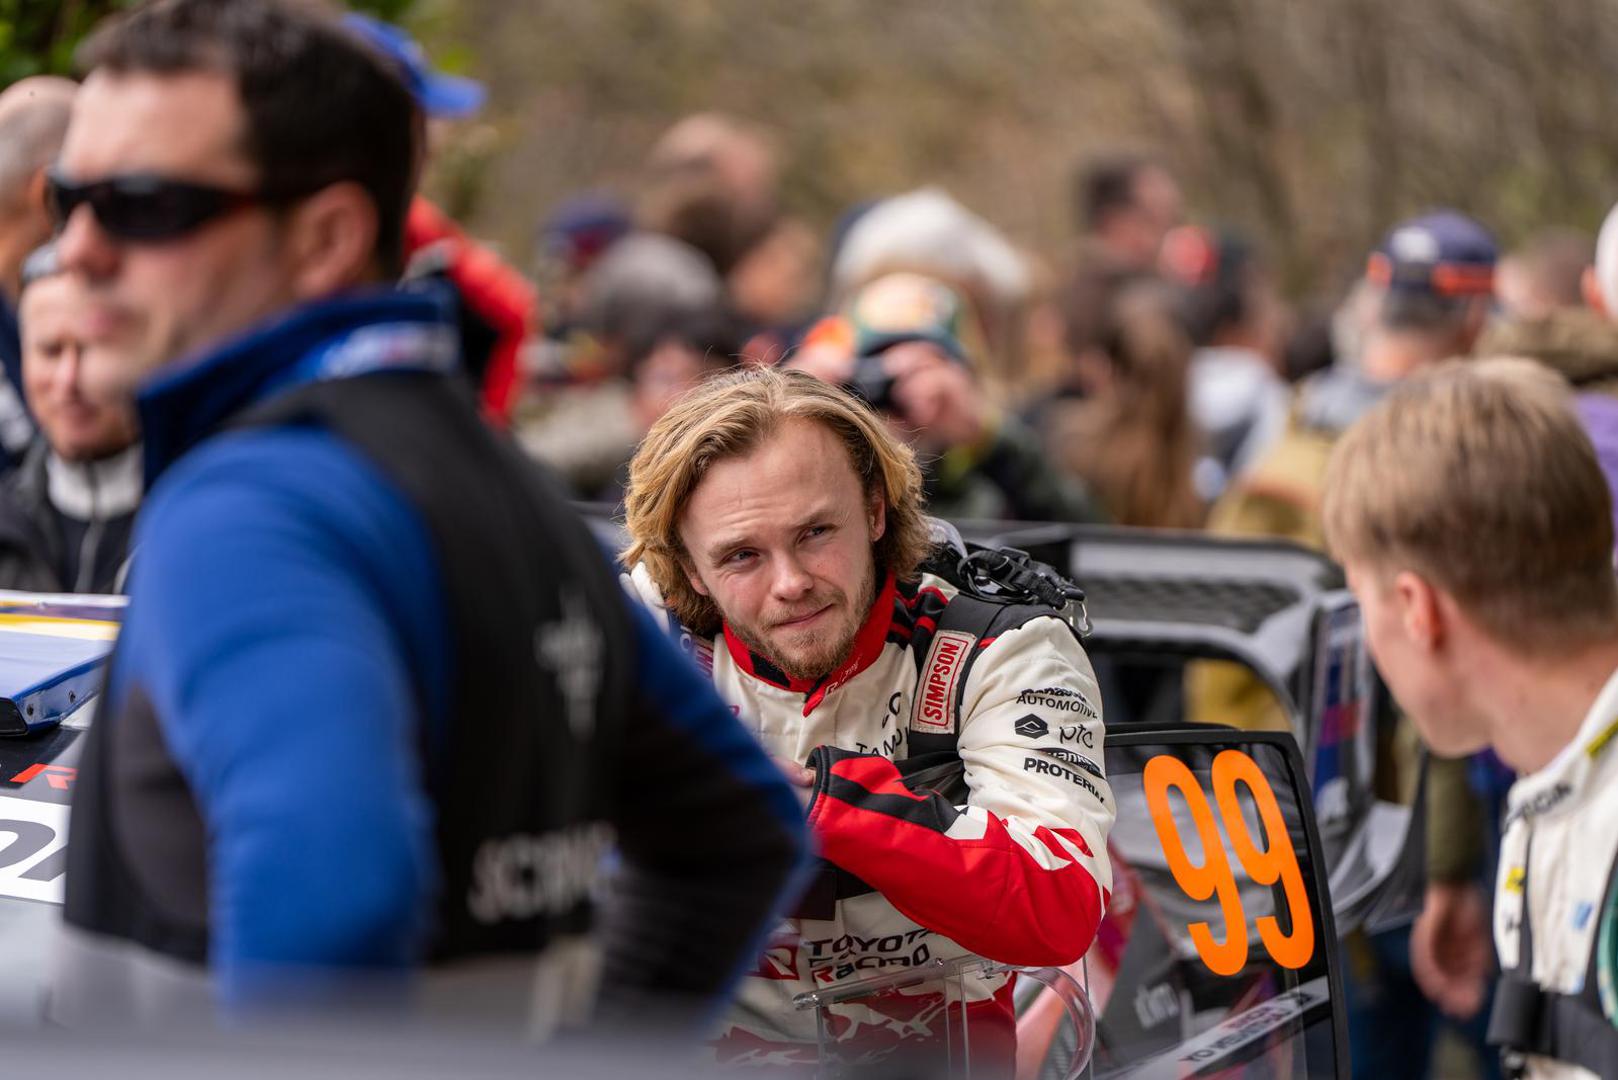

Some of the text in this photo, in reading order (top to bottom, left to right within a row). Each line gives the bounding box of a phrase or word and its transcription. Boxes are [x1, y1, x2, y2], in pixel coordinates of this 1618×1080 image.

[924, 642, 960, 721] SIMPSON
[1059, 723, 1094, 749] ptc
[1143, 750, 1315, 976] 99
